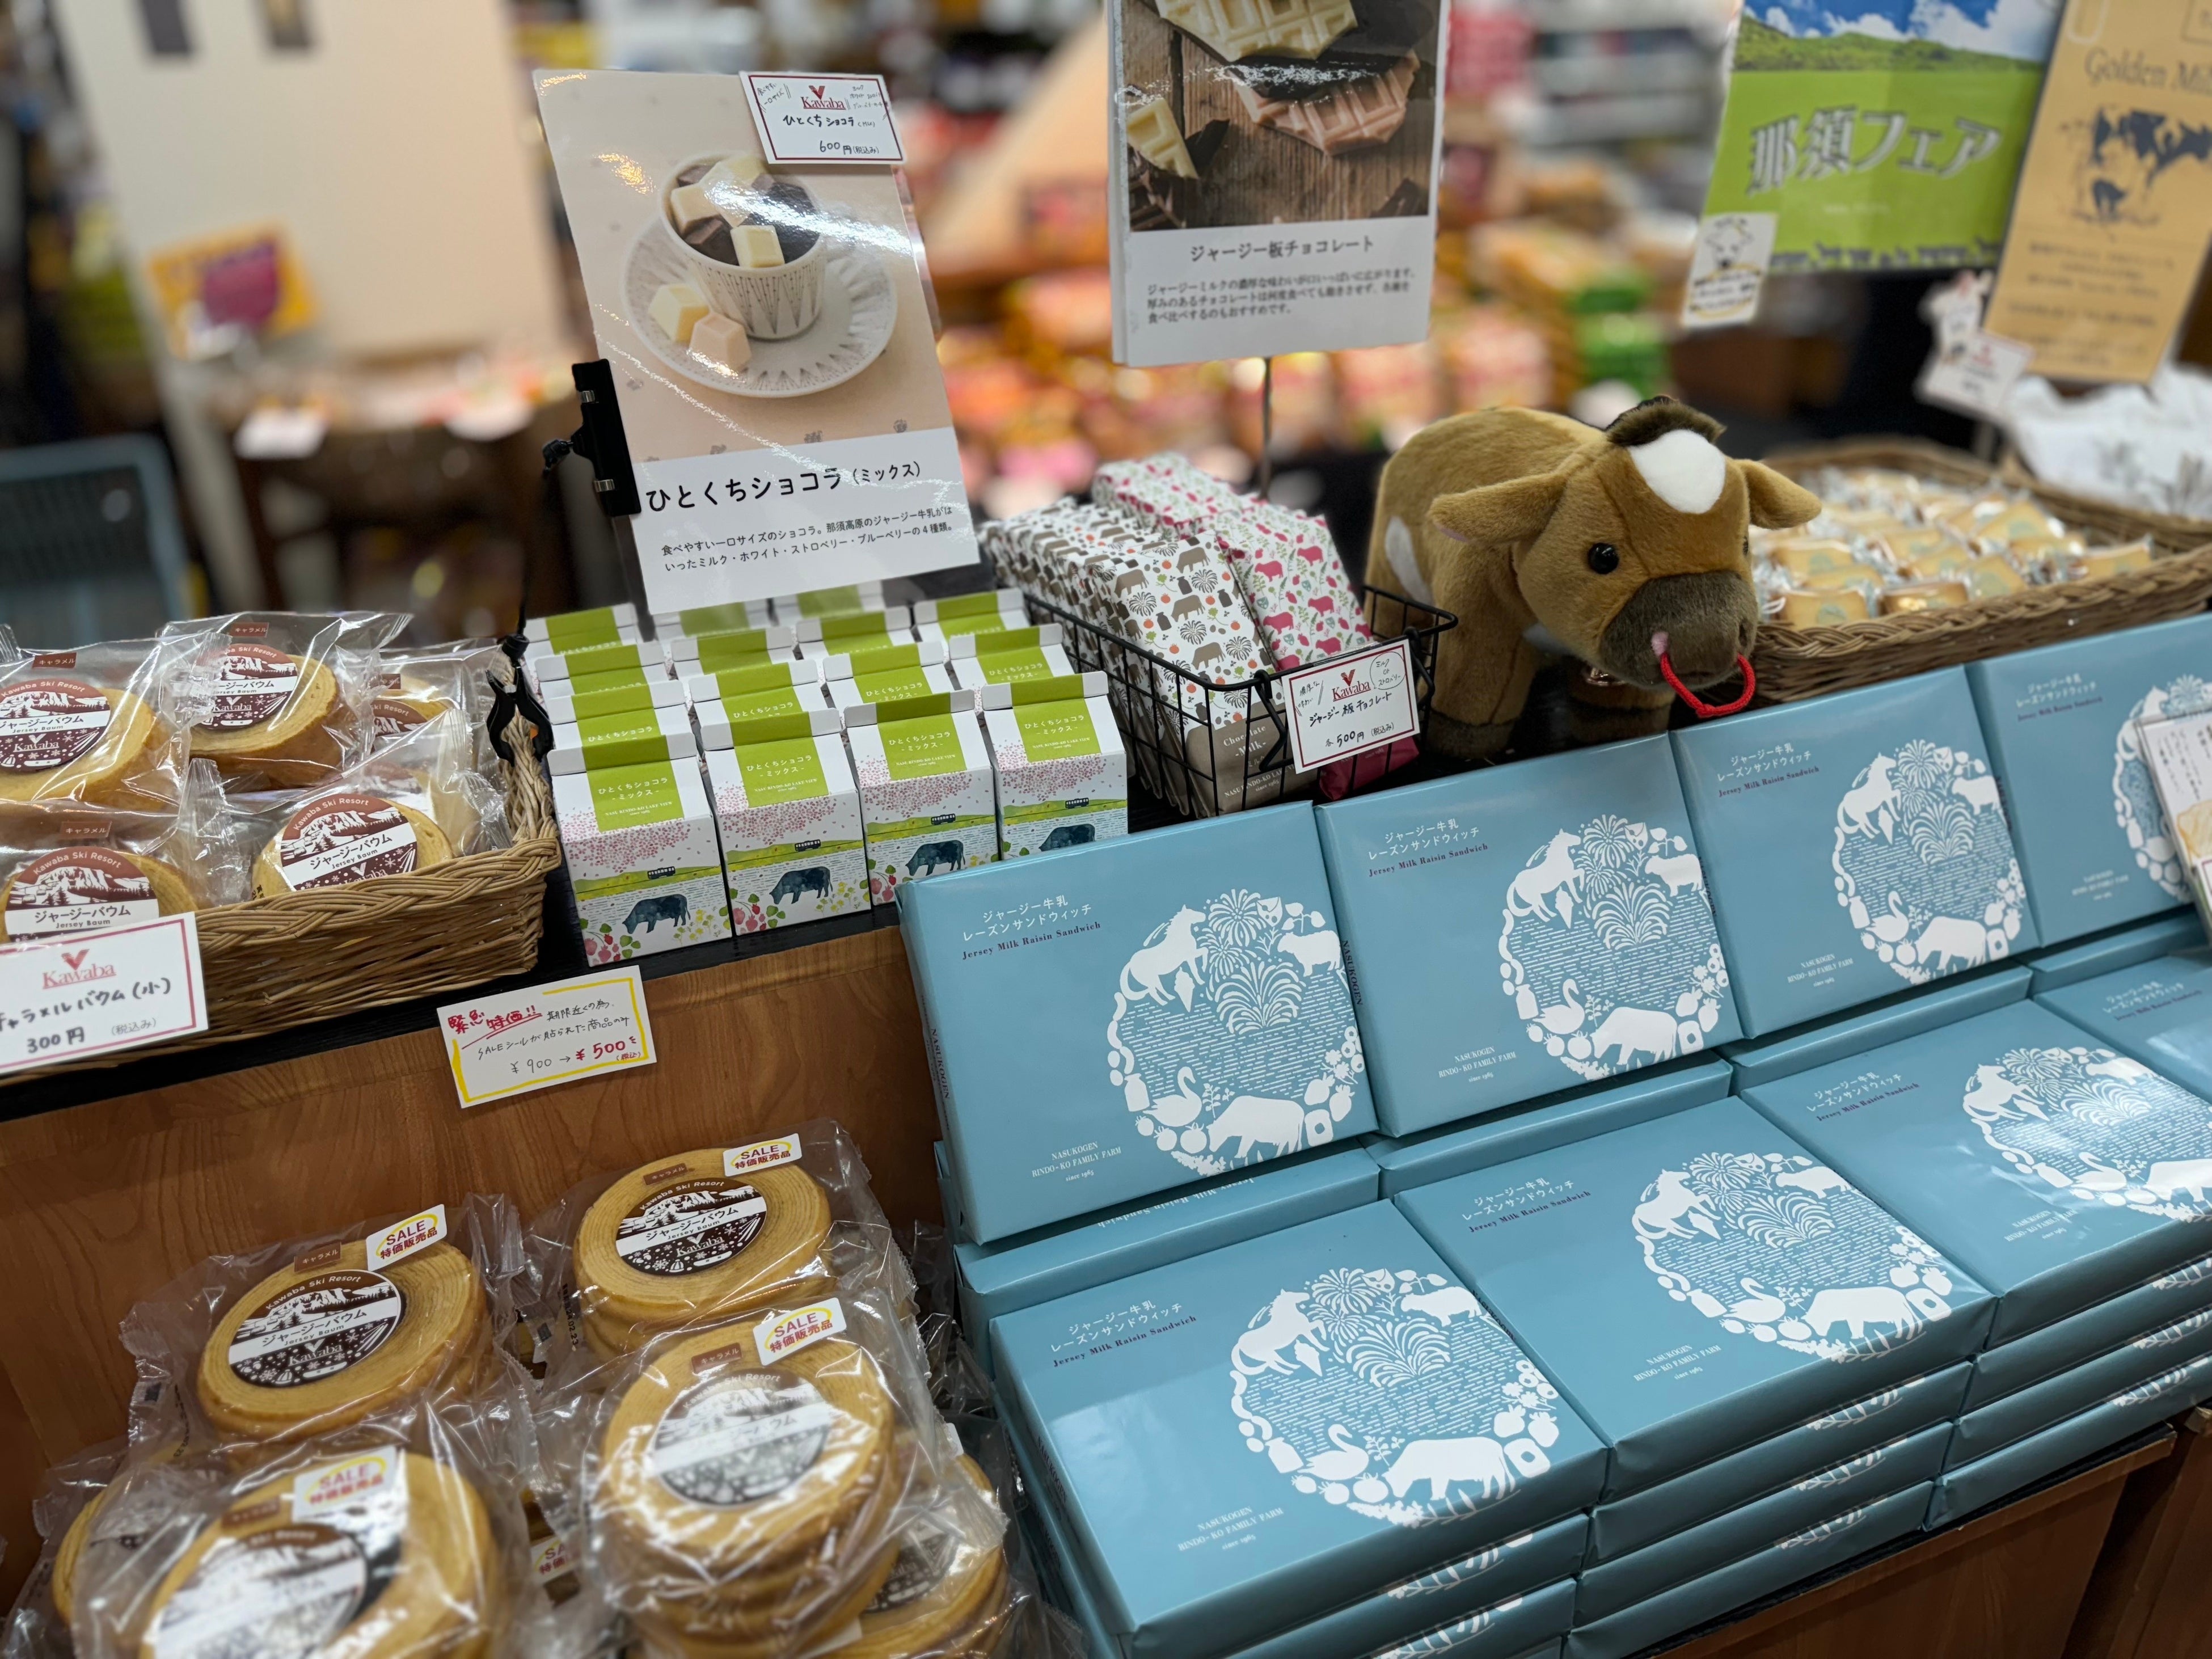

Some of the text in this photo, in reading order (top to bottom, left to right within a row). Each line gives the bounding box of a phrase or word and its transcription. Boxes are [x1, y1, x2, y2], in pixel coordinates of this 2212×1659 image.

[800, 96, 846, 109] Kawaba
[1747, 105, 2002, 196] 那須フェア
[1191, 235, 1373, 262] ジャージー板チョコレート
[254, 647, 277, 658] Resort
[1376, 659, 1390, 668] ミルク
[989, 662, 1043, 676] ひとくちショコラ
[1, 683, 37, 698] Kawaba
[57, 681, 85, 693] Resort
[866, 682, 922, 697] ひとくちショコラ
[1332, 681, 1371, 702] Kawaba
[213, 702, 252, 712] Kawaba
[384, 703, 410, 716] Resort
[733, 702, 793, 718] ひとくちショコラ
[1024, 715, 1084, 729] ひとくちショコラ
[588, 726, 652, 742] ひとくちショコラ
[889, 731, 951, 745] ひとくちショコラ
[1223, 725, 1266, 747] Choclate
[14, 740, 60, 752] Kawaba
[1731, 742, 1794, 766] ジャージー牛乳
[746, 755, 812, 771] ひとくちショコラ
[1717, 750, 1811, 782] レーズンサンドウィッチ
[598, 778, 668, 794] ひとくちショコラ
[1224, 787, 1240, 797] NASU
[1719, 766, 1820, 797] Jersey Milk Raisin Sandwich
[293, 797, 369, 830] Kawaba Ski Resort
[1384, 818, 1459, 843] ジャージー牛乳
[310, 834, 392, 869] ジャージーバウム
[1369, 827, 1479, 860] レーズンサンドウィッチ
[33, 854, 69, 875] Kawaba
[91, 852, 122, 868] Resort
[331, 849, 378, 869] Jersey Baum
[1369, 843, 1488, 877] Jersey Milk Raisin Sandwich
[35, 905, 132, 923] ジャージーバウム
[983, 894, 1068, 923] ジャージー牛乳
[963, 904, 1092, 941] レーズンサンドウィッチ
[962, 922, 1101, 960] Jersey Milk Raisin Sandwich
[42, 964, 117, 990] Kawaba
[931, 1028, 950, 1099] NASUKOGEN
[1454, 1046, 1495, 1063] NASUKOGEN
[1474, 1057, 1497, 1069] FAMILY
[1498, 1051, 1516, 1062] FARM
[1806, 1074, 1902, 1112] レーズンサンドウィッチ
[1814, 1071, 1880, 1099] ジャージー牛乳
[734, 1150, 792, 1170] 特価販売品
[740, 1144, 780, 1160] SALE
[1052, 1141, 1098, 1161] NASUKOGEN
[1073, 1153, 1099, 1166] FAMILY
[1101, 1146, 1121, 1159] FARM
[1081, 1169, 1094, 1178] 1965
[639, 1189, 673, 1210] Kawaba
[676, 1182, 691, 1191] Ski
[1462, 1180, 1574, 1220] レーズンサンドウィッチ
[1474, 1177, 1550, 1206] ジャージー牛乳
[1469, 1191, 1591, 1232] Jersey Milk Raisin Sandwich
[386, 1220, 427, 1246] SALE
[645, 1206, 738, 1241] ジャージーバウム
[668, 1220, 720, 1240] Jersey Baum
[380, 1227, 438, 1260] 特価販売品
[676, 1235, 725, 1257] Kawaba
[302, 1248, 339, 1264] キャラメル
[265, 1285, 306, 1310] Kawaba
[309, 1278, 324, 1287] Ski
[262, 1310, 367, 1347] ジャージーバウム
[774, 1312, 818, 1337] SALE
[1050, 1303, 1182, 1352] レーズンサンドウィッチ
[1069, 1300, 1156, 1335] ジャージー牛乳
[284, 1325, 345, 1346] Jersey Baum
[770, 1319, 834, 1353] 特価販売品
[1053, 1315, 1196, 1367] Jersey Milk Raisin Sandwich
[289, 1344, 343, 1366] Kawaba
[700, 1347, 740, 1365] キャラメル
[1646, 1344, 1692, 1366] NASUKOGEN
[1673, 1353, 1700, 1367] FAMILY
[1700, 1345, 1722, 1357] FARM
[745, 1373, 782, 1382] Resort
[319, 1463, 369, 1487] SALE
[1197, 1506, 1253, 1531] NASUKOGEN
[1225, 1517, 1257, 1534] FAMILY
[1259, 1508, 1284, 1522] FARM
[1222, 1534, 1256, 1550] since 1965
